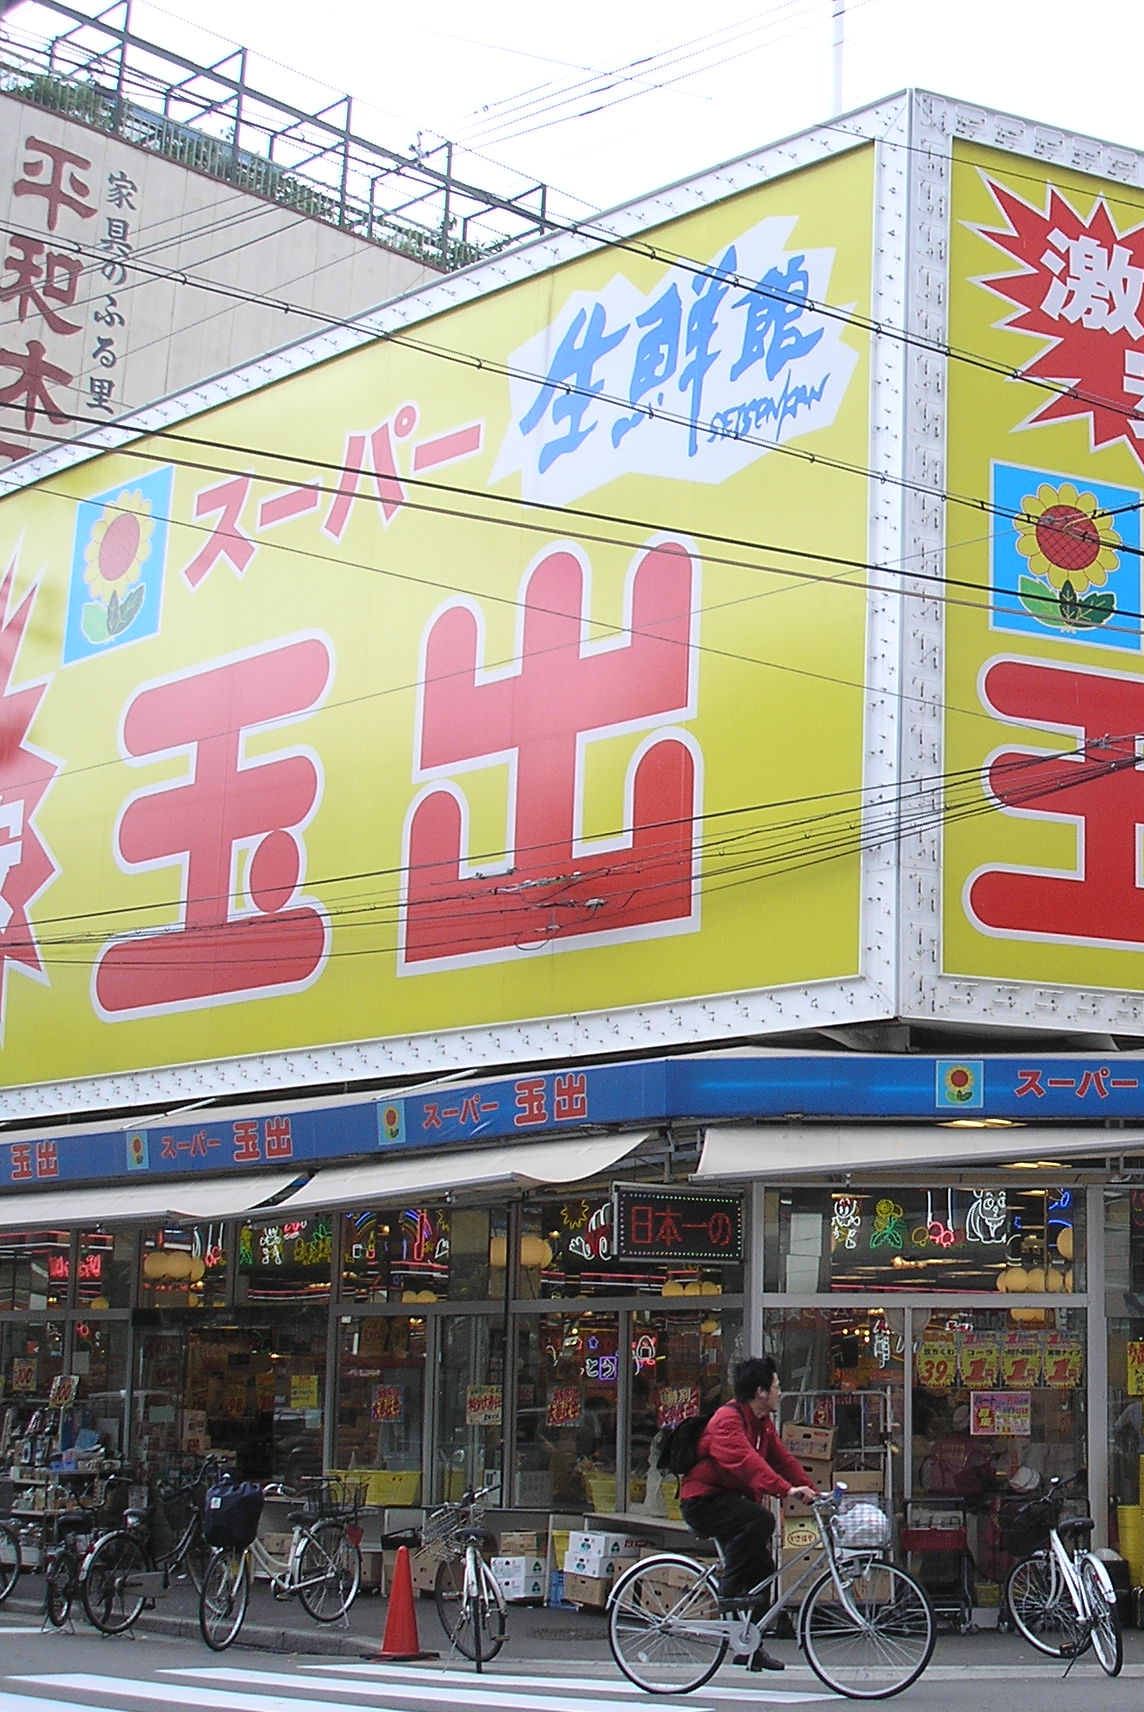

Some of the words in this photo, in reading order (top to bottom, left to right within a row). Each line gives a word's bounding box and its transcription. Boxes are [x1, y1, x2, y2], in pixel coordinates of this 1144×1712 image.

[0, 136, 97, 461] 平和木
[86, 171, 138, 414] 家具のふる里
[519, 245, 825, 474] 生鮮館
[180, 401, 485, 591] スーパー
[91, 531, 703, 1024] 玉出
[161, 1130, 222, 1159] スーパー
[233, 1116, 293, 1163] 玉出
[422, 1094, 498, 1130] スーパー
[514, 1073, 588, 1126] 玉出
[1014, 1067, 1138, 1099] スーパー
[11, 1139, 59, 1180] 玉出
[630, 1205, 733, 1247] 日本一の
